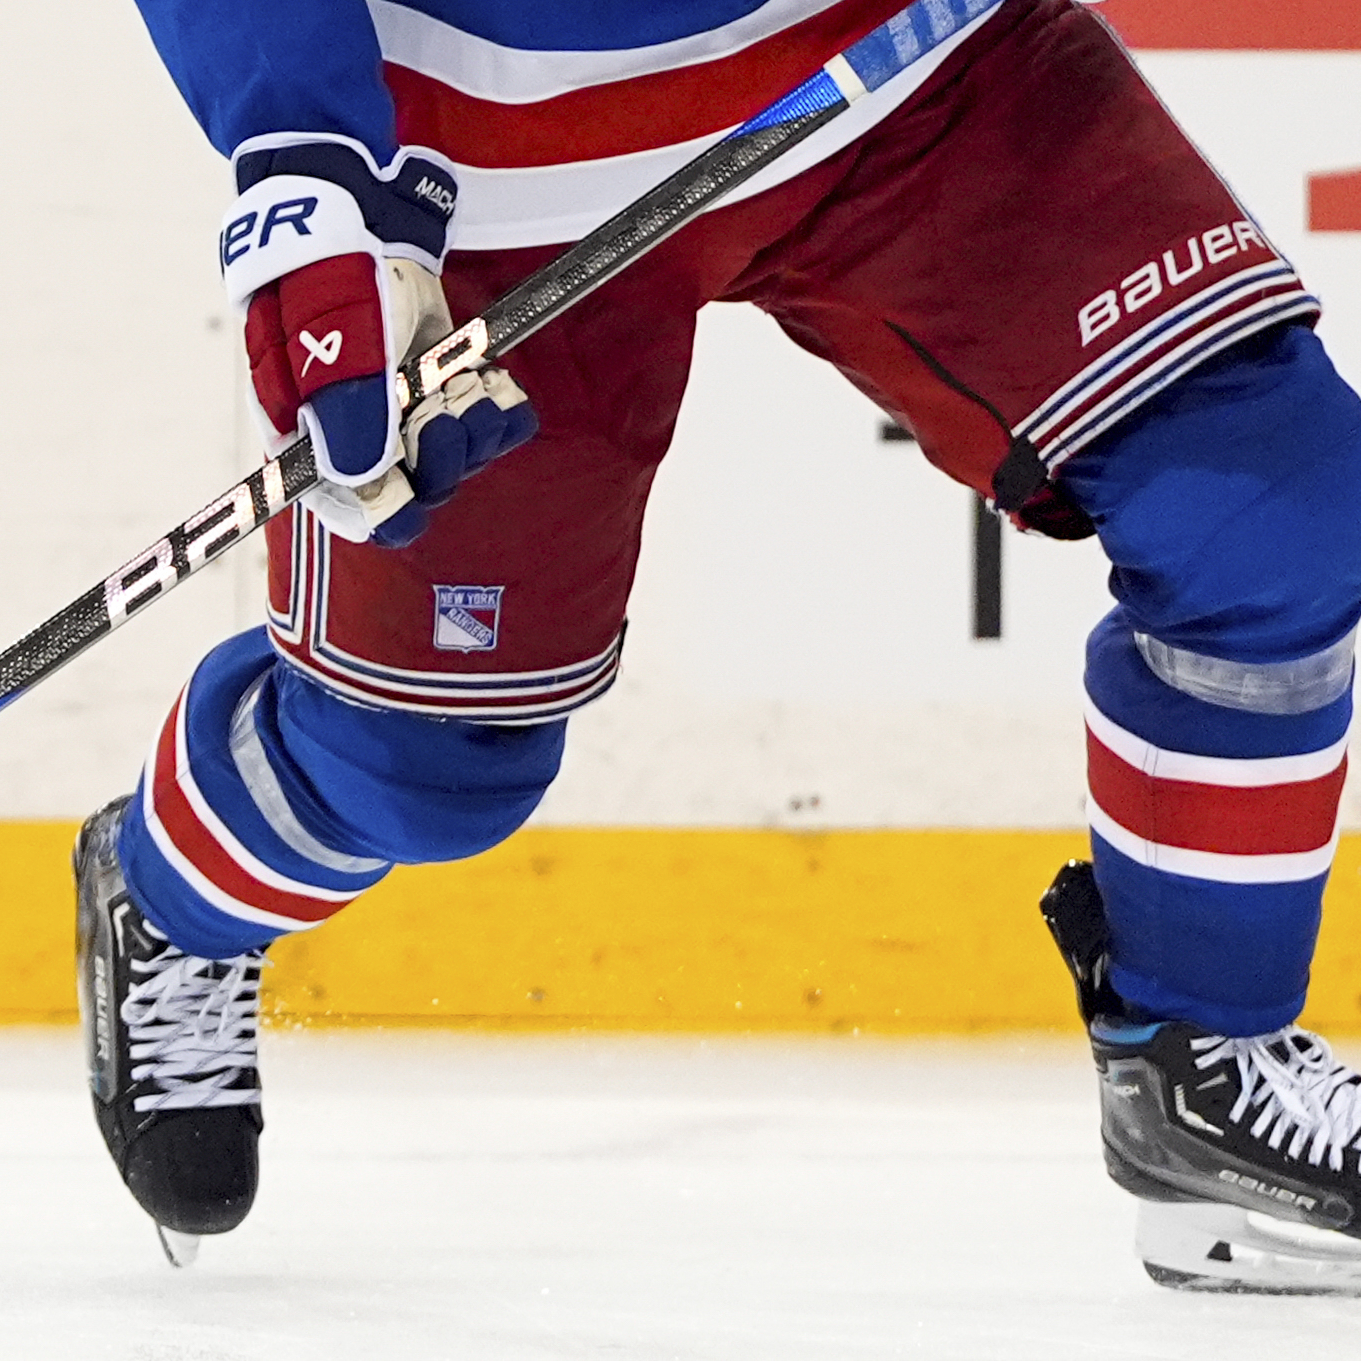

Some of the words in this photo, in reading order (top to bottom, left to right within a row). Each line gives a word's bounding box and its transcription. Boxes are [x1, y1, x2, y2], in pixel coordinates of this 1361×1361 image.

[414, 175, 456, 215] MACH
[220, 196, 319, 279] ER
[1078, 220, 1266, 348] BAUER
[102, 316, 489, 634] BAR
[439, 591, 465, 606] NEW
[466, 591, 496, 606] YORK
[446, 607, 493, 645] RANGERS
[94, 954, 110, 1061] BAUER
[1218, 1168, 1317, 1211] BAUER
